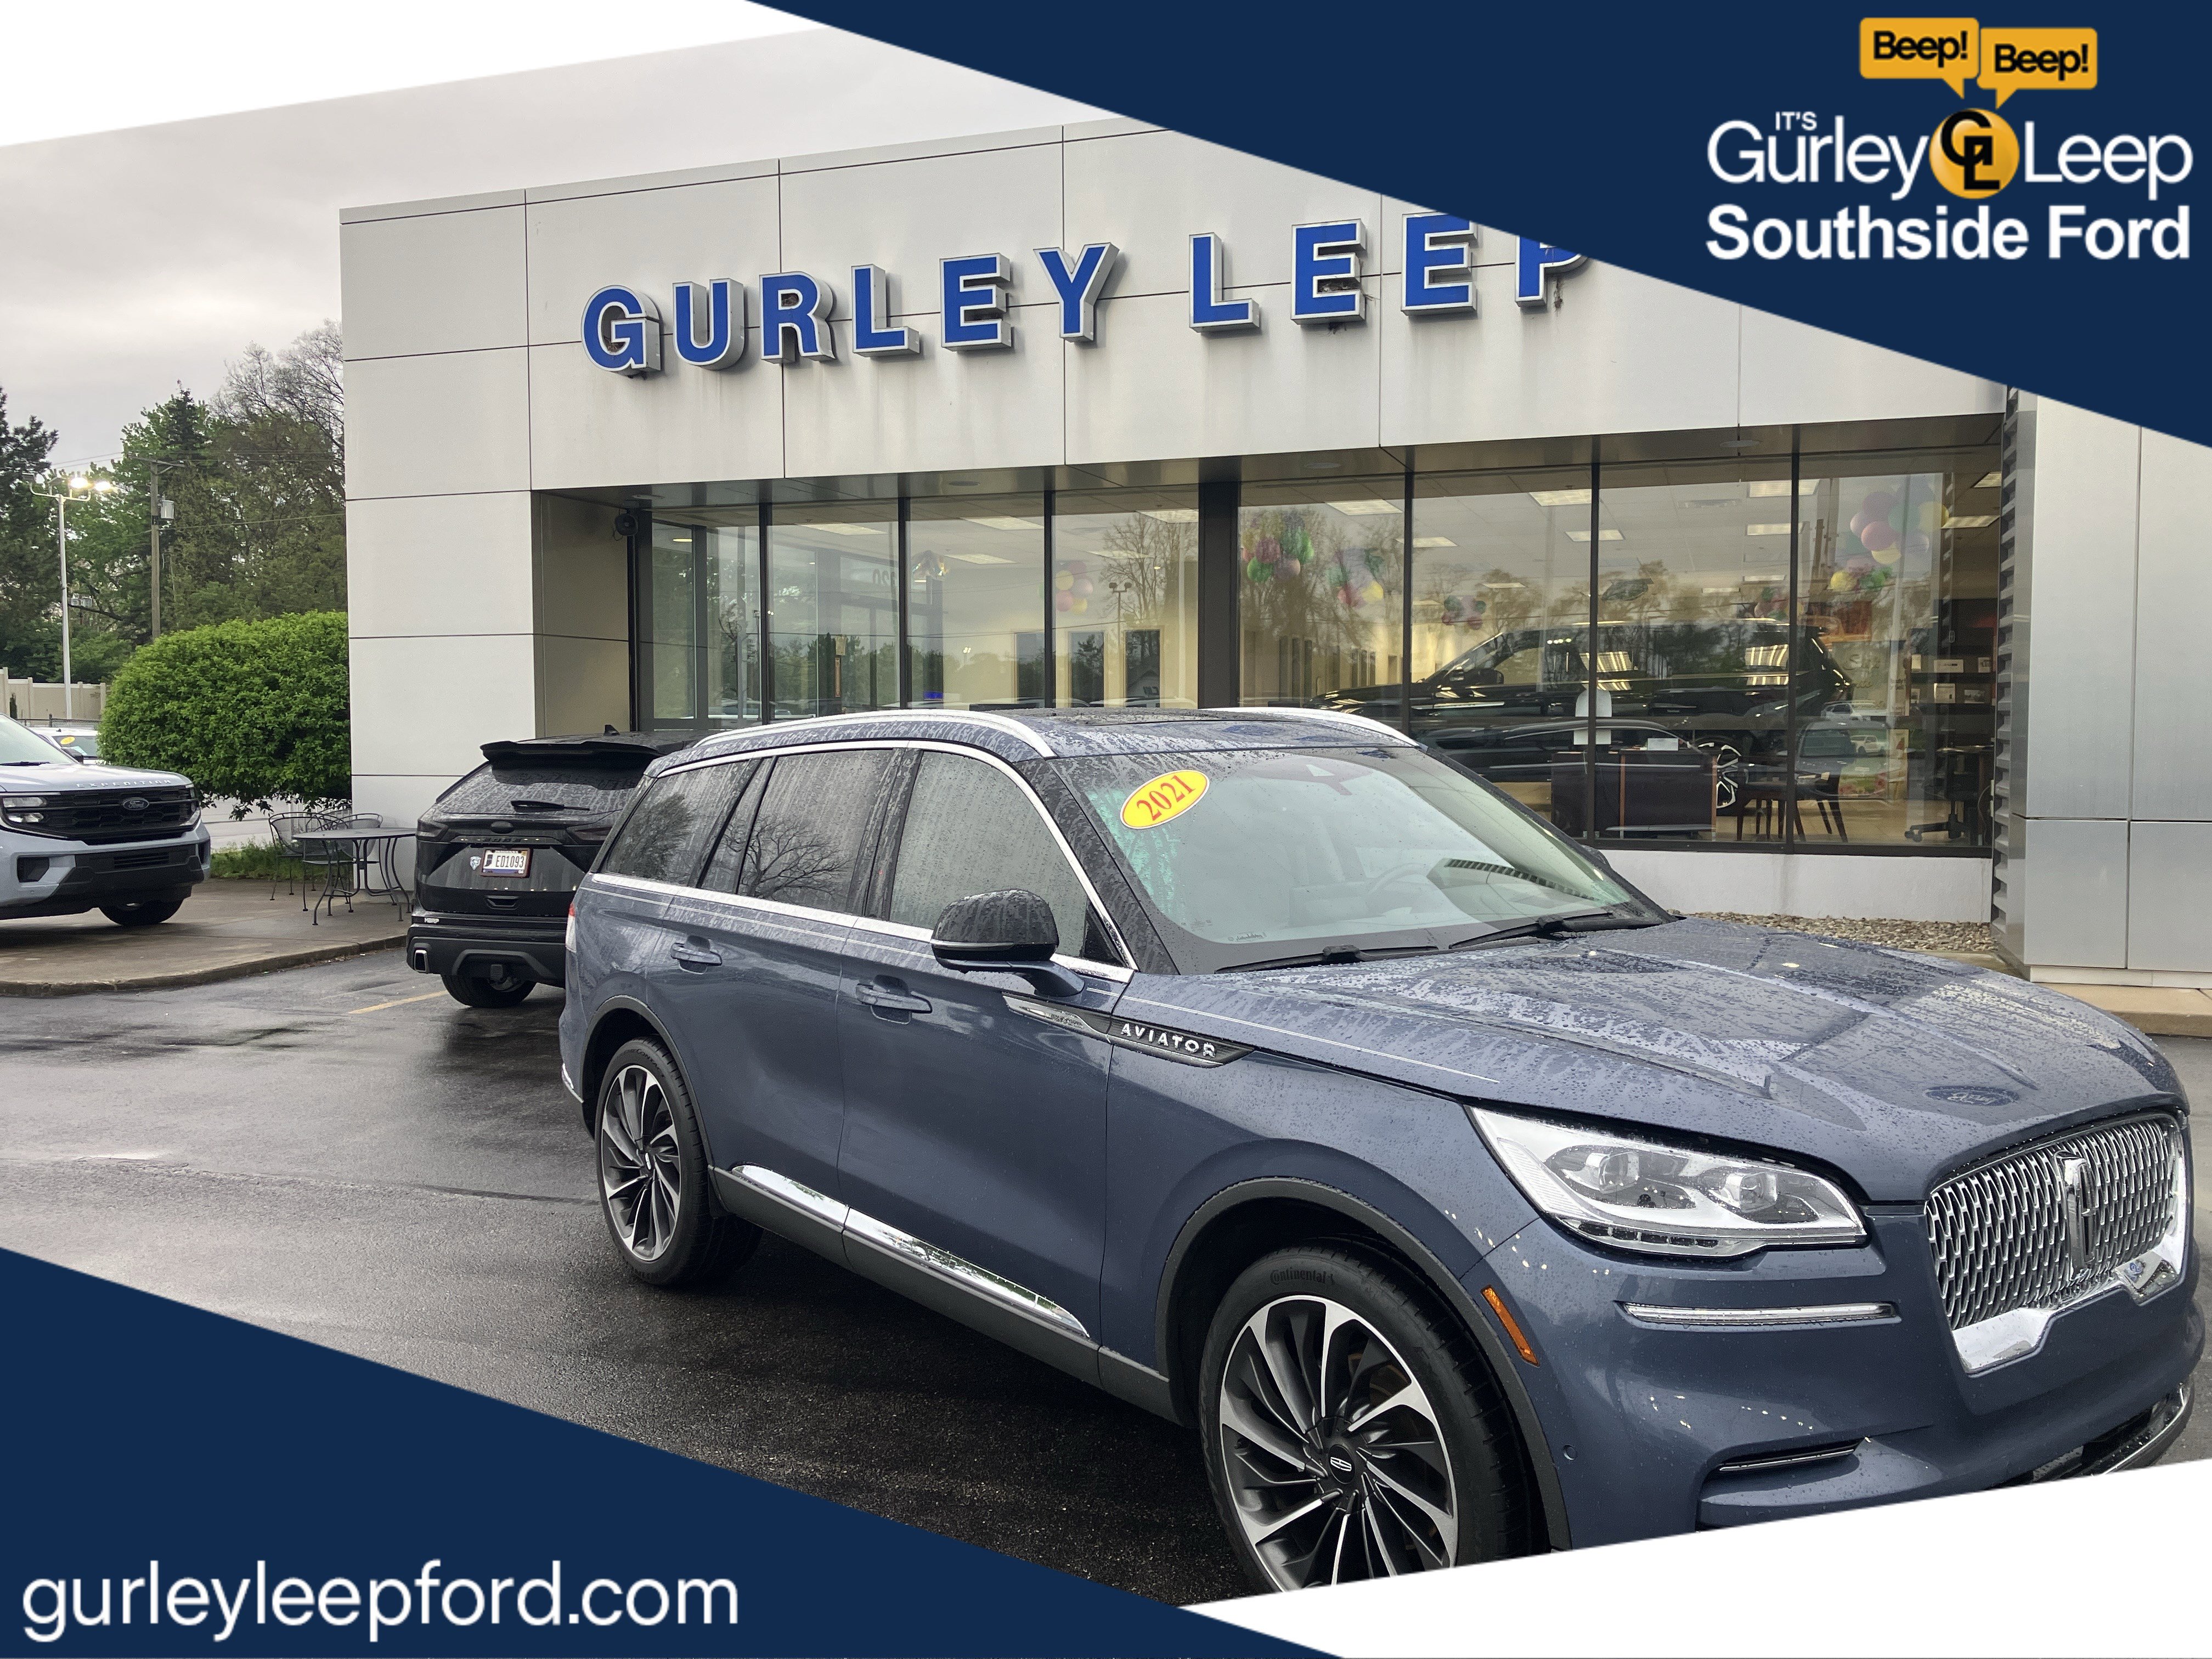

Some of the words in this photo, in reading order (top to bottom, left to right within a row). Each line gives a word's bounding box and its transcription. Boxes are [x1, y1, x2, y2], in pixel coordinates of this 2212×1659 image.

[582, 242, 1118, 373] GURLEY
[1189, 212, 1588, 332] LEEP
[1137, 775, 1196, 821] 2021
[495, 855, 524, 868] ED1093
[1121, 1023, 1217, 1059] AVIATOR
